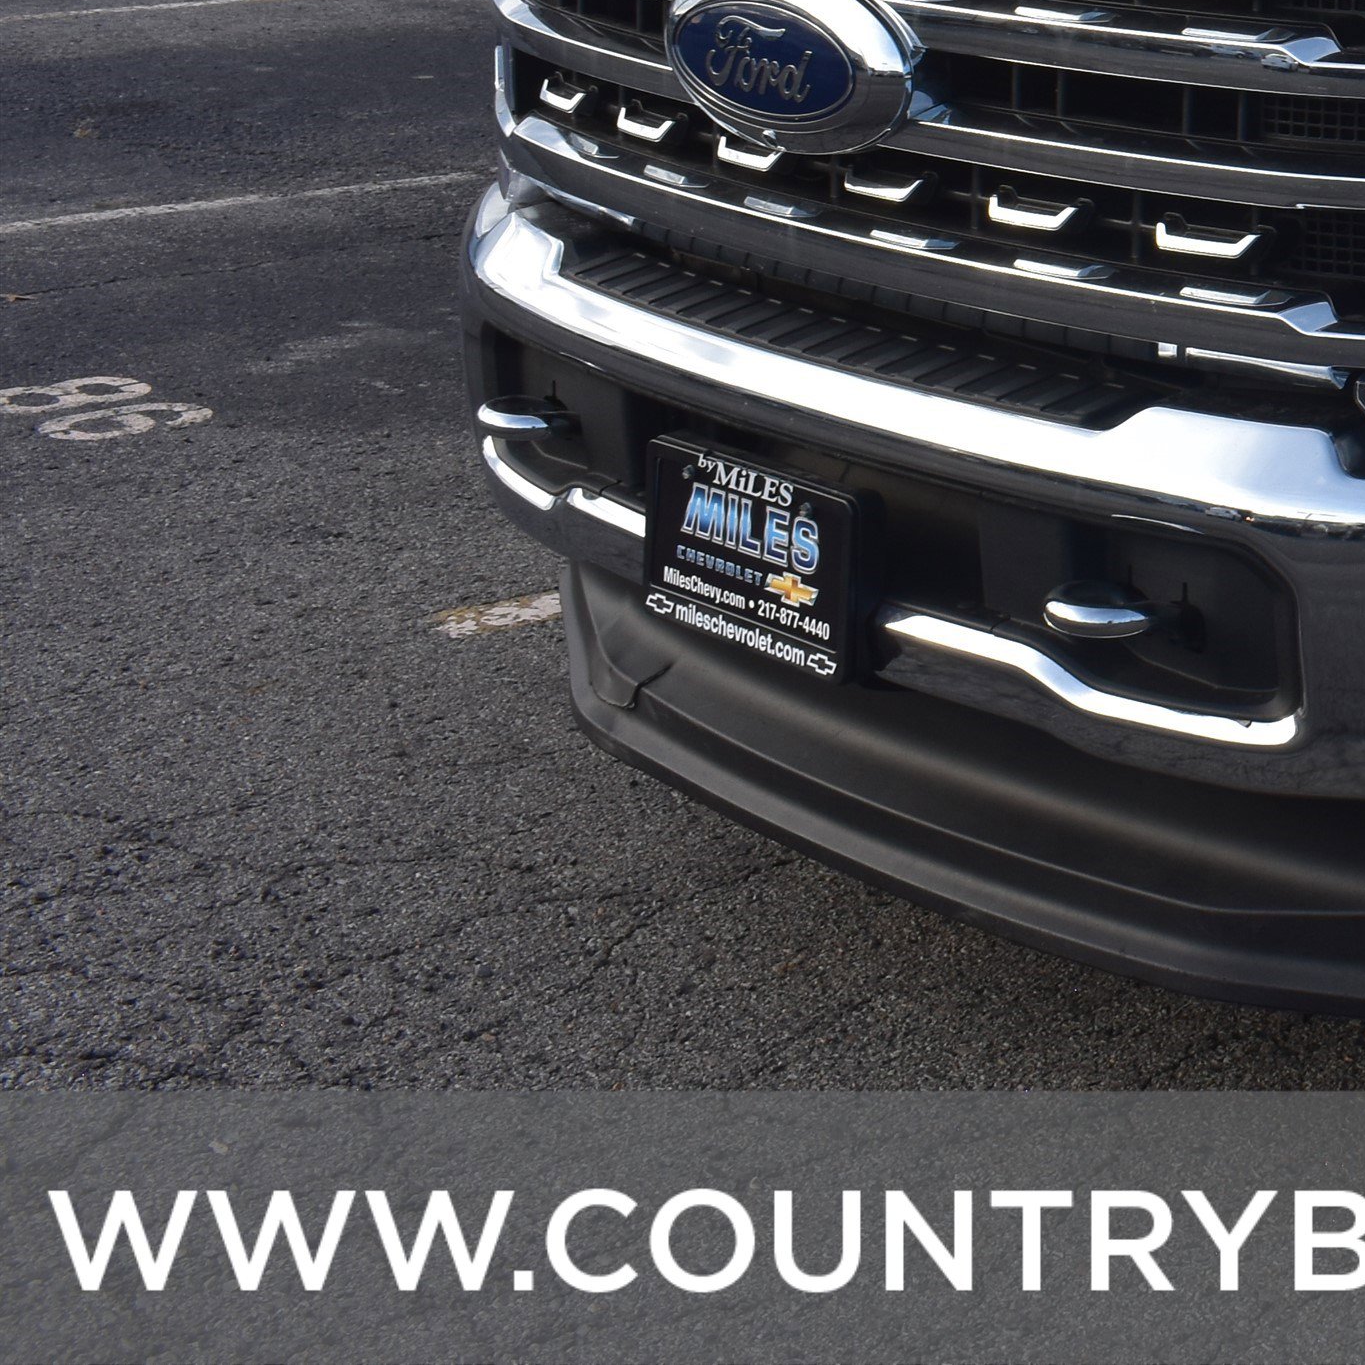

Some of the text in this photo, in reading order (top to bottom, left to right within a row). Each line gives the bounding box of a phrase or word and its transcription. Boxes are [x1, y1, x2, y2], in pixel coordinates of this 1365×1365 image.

[705, 15, 815, 103] Ford
[697, 453, 715, 473] by
[680, 482, 820, 575] MILES
[676, 543, 763, 586] CHEVROLET
[663, 565, 831, 641] MilesChevy.com 217-877-4440
[675, 602, 806, 667] mileschevrolet.com
